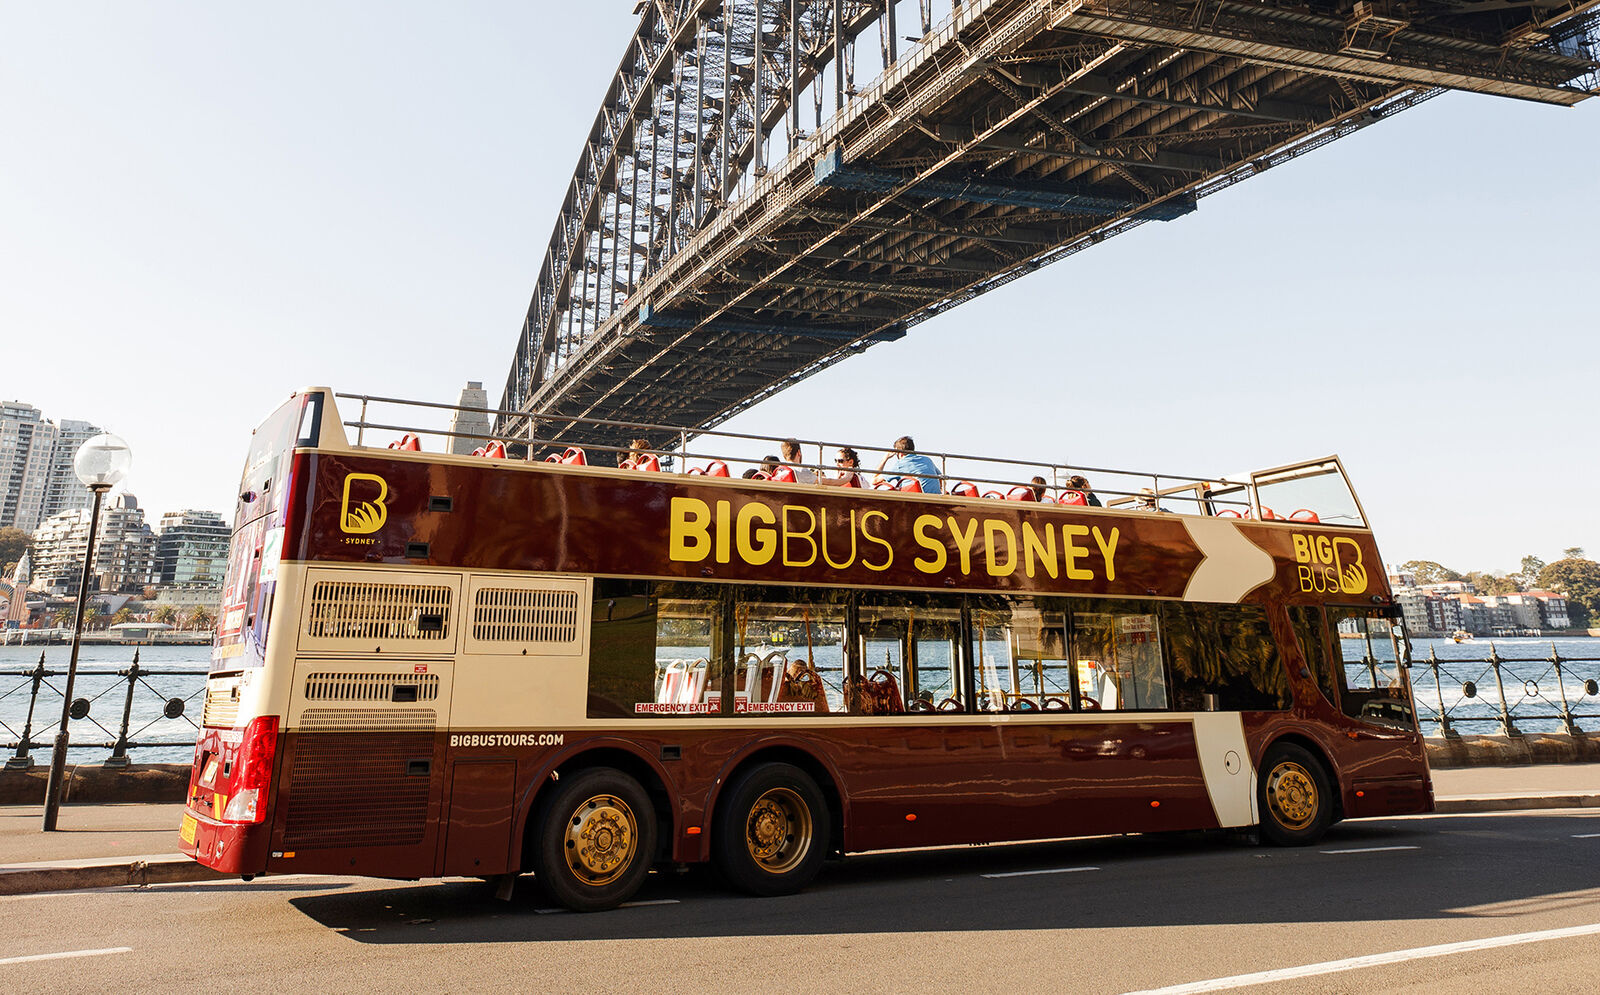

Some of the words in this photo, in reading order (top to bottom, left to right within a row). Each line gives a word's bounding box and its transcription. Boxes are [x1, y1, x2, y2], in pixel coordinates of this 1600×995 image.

[345, 537, 376, 545] SYDNEY
[913, 514, 1120, 581] SYDNEY
[1292, 533, 1333, 564] BIG
[1298, 565, 1339, 593] BUS
[636, 703, 687, 712] EMERGENCY
[689, 703, 708, 712] EXIT
[748, 703, 794, 711] EMERGENCY
[796, 702, 814, 711] EXIT
[450, 734, 564, 747] BIGBUSTOURS.COM
